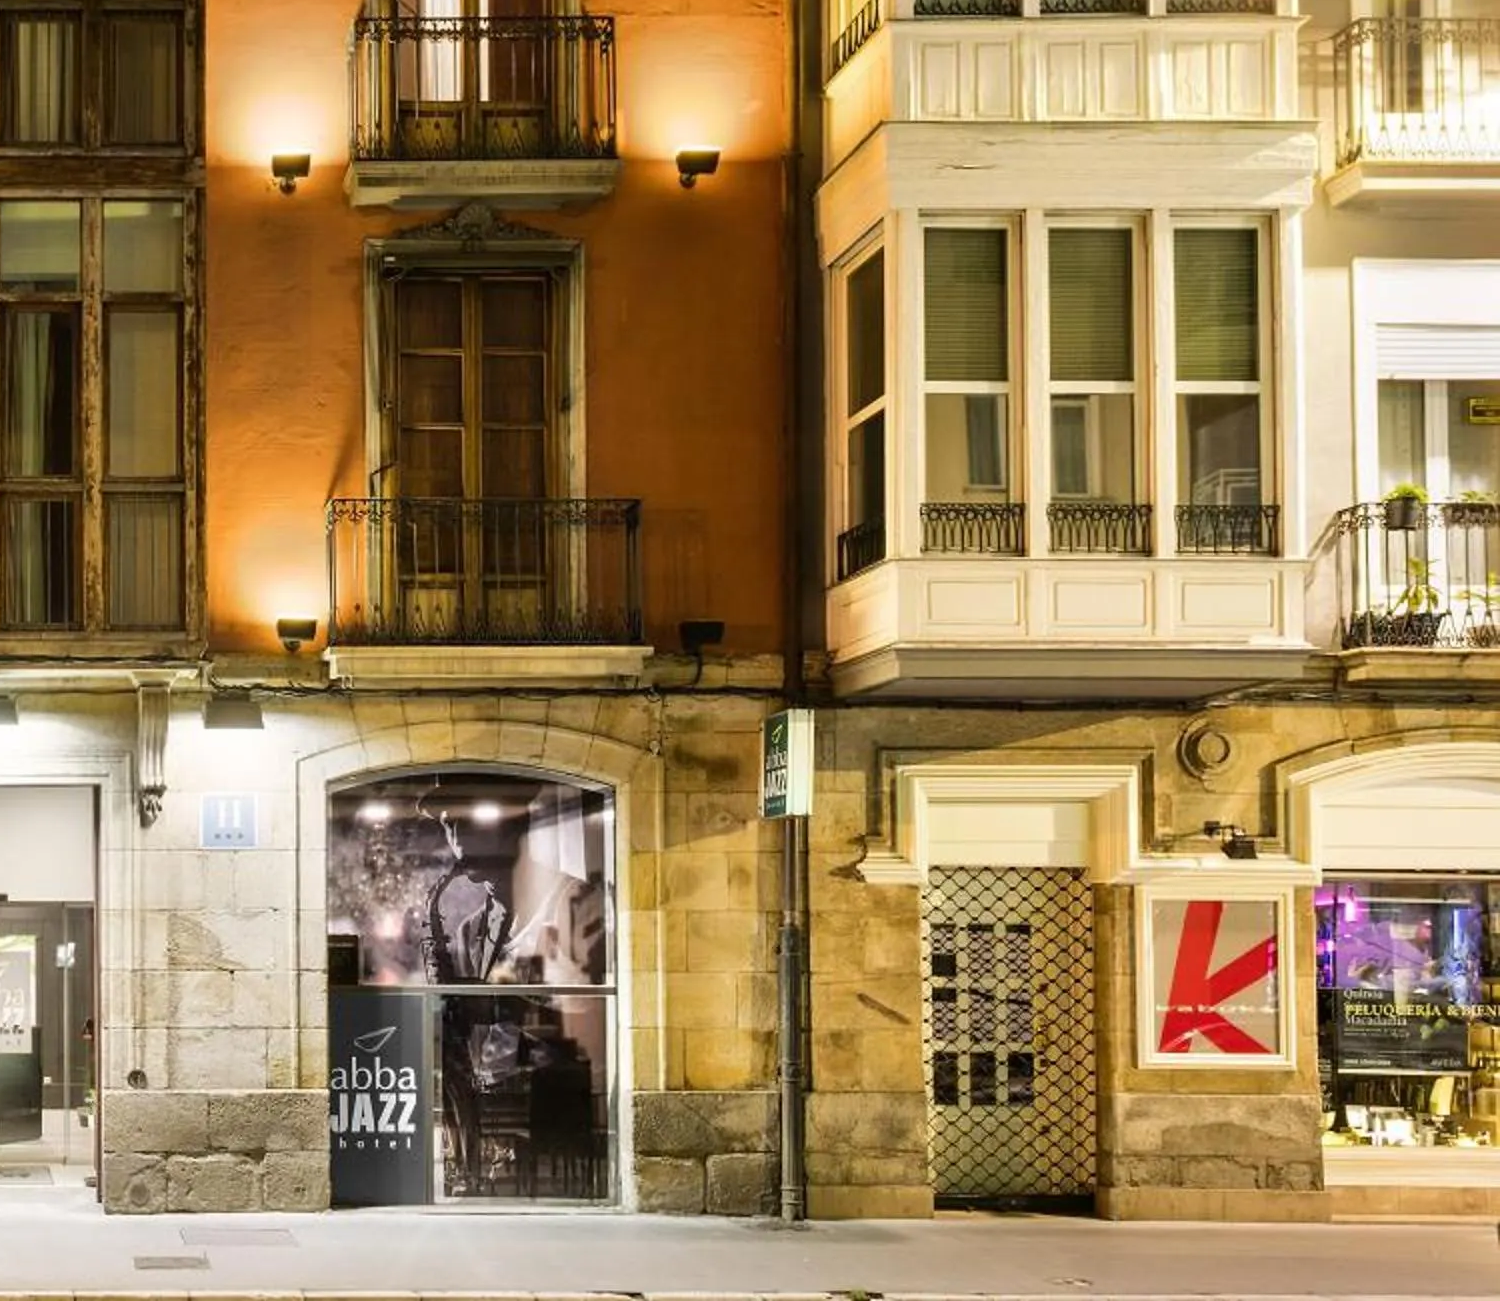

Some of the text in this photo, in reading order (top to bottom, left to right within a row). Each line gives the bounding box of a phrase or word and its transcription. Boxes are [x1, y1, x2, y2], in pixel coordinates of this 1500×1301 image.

[331, 1056, 417, 1090] abba
[330, 1092, 417, 1133] JAZZ
[340, 1137, 411, 1149] hotel
